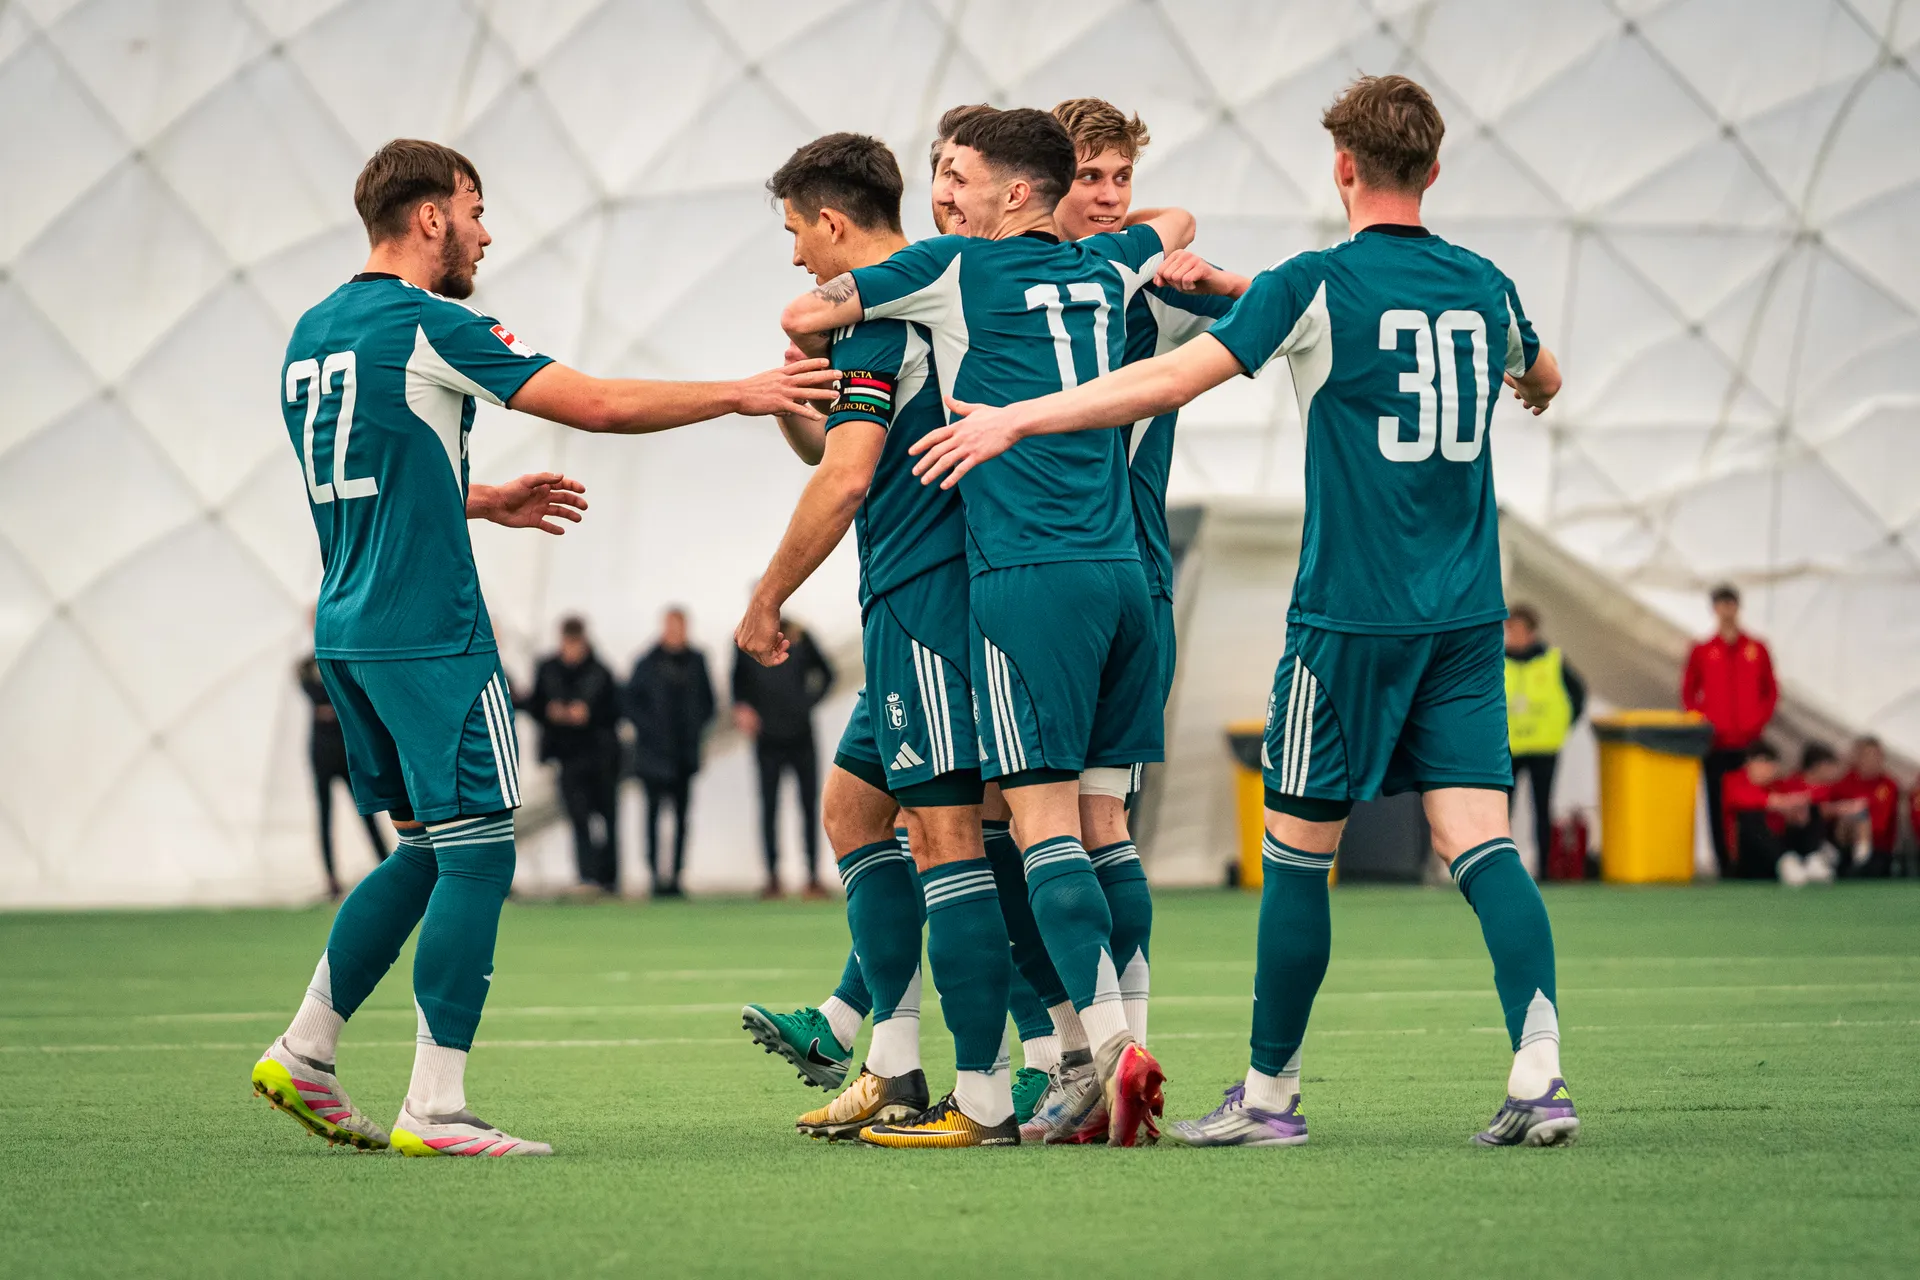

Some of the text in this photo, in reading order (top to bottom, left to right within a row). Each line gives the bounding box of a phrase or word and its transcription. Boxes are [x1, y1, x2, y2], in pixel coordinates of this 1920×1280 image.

[843, 371, 872, 379] VICTA
[1024, 283, 1112, 391] 17
[1378, 309, 1490, 462] 30
[286, 350, 379, 504] 22
